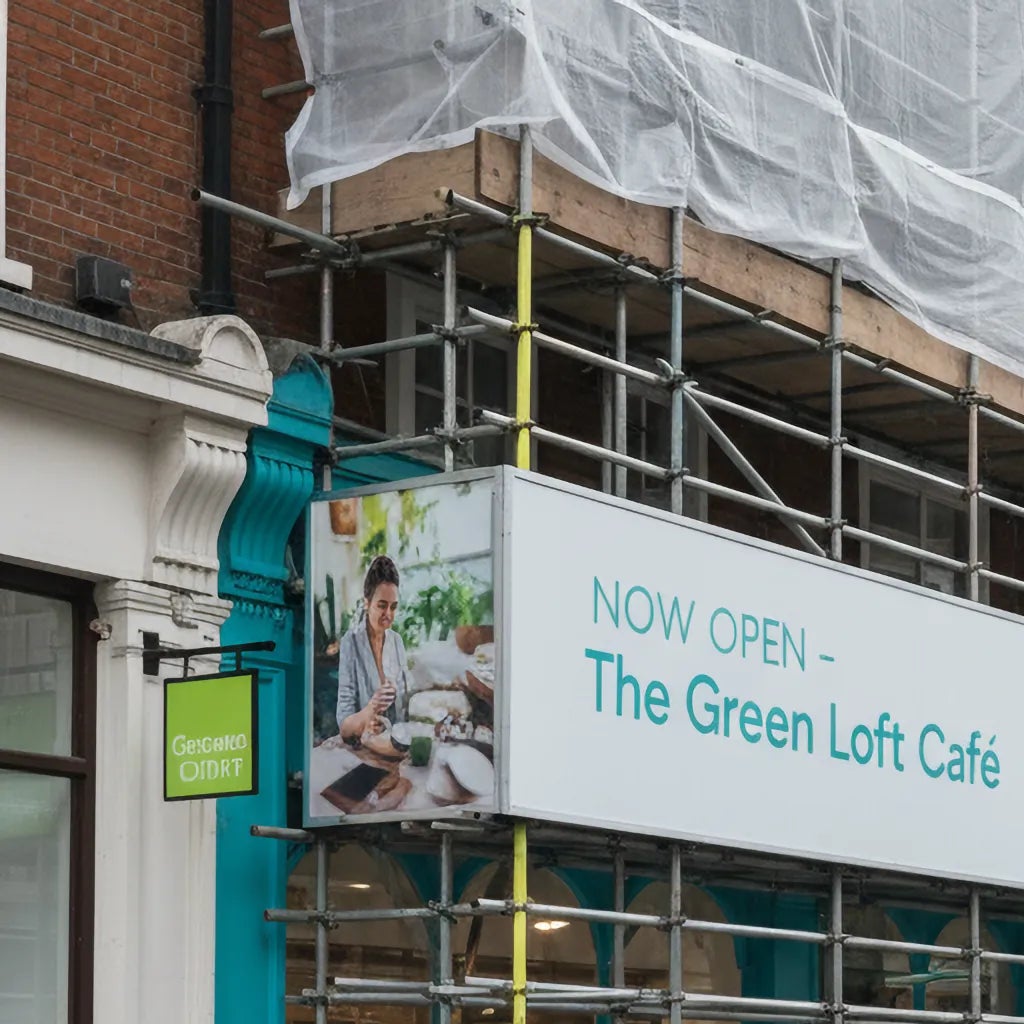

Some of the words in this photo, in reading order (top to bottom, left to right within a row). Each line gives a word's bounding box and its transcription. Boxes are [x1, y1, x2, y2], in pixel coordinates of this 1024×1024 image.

[592, 575, 696, 645] NOW
[709, 606, 806, 673] OPEN
[583, 647, 671, 726] The
[684, 673, 814, 755] Green
[829, 702, 907, 773] Loft
[917, 723, 1001, 790] Café
